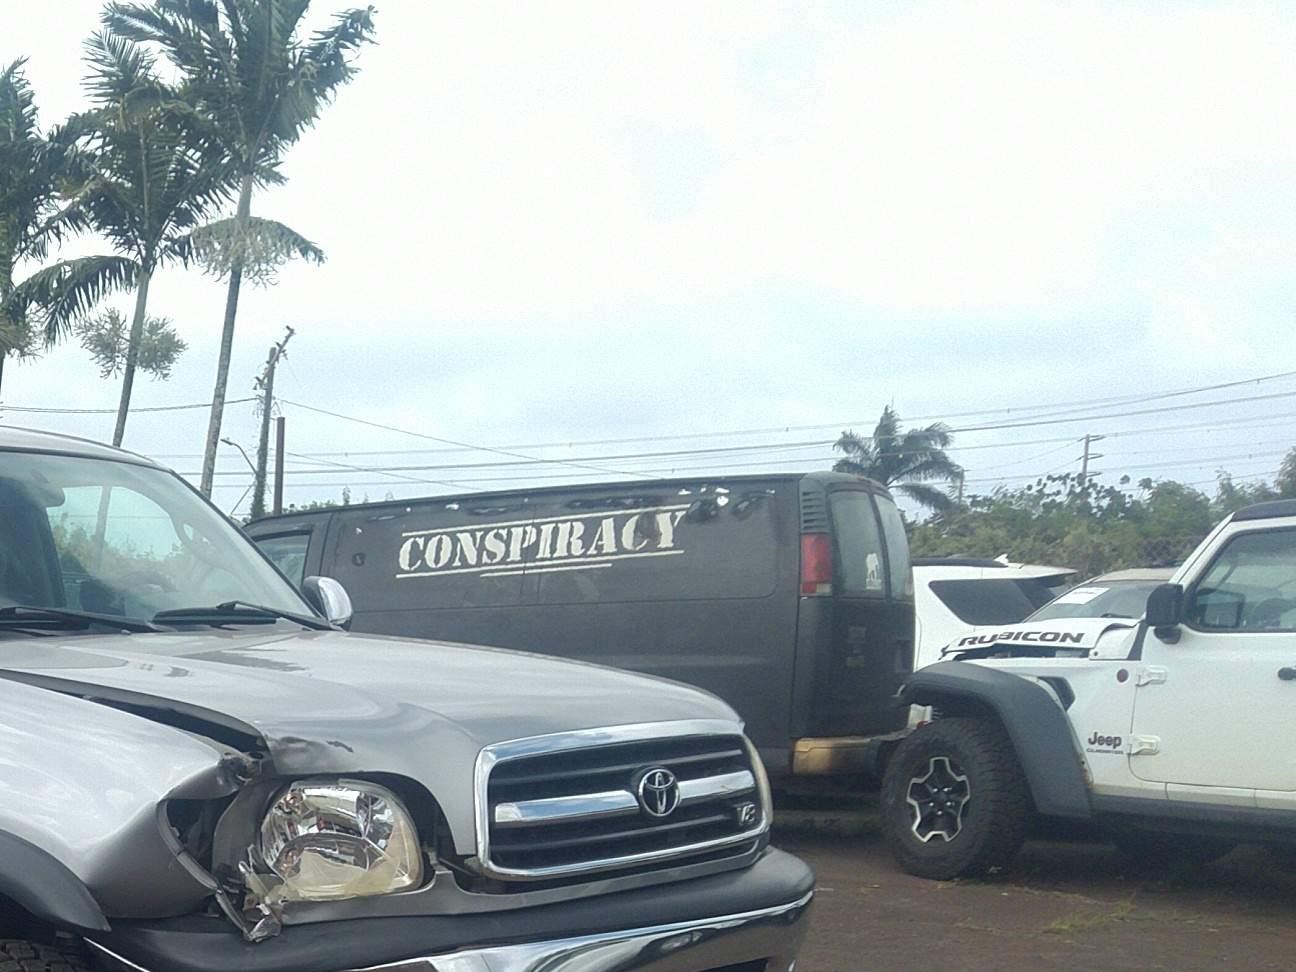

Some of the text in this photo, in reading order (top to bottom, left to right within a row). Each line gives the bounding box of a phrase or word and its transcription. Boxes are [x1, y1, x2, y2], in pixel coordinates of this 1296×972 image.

[398, 510, 687, 572] CONSPIRACY
[958, 631, 1086, 647] RUBICON
[1088, 731, 1123, 749] Jeep
